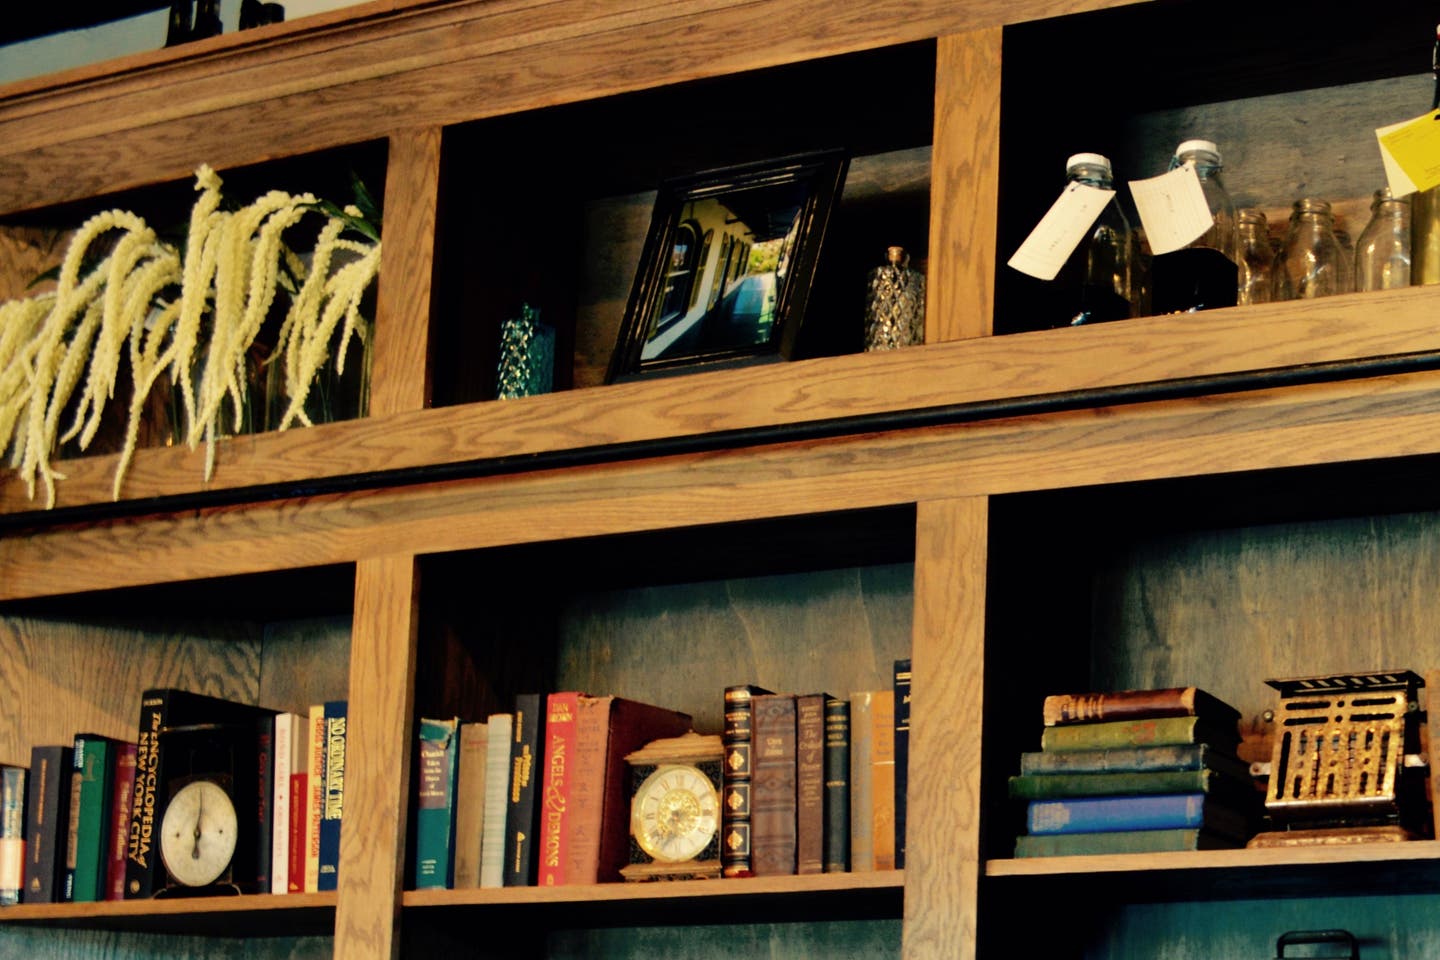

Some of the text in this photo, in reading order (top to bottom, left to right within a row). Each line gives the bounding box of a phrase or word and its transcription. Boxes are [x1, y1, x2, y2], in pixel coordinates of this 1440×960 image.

[332, 717, 346, 735] NO
[330, 735, 345, 791] ORDINARY
[552, 735, 566, 787] ANGELS
[129, 732, 149, 867] NEW YORK CITY
[142, 728, 161, 851] ENCYCLOPEDIA
[311, 810, 321, 858] PATTERSON
[546, 812, 561, 867] DEMONS
